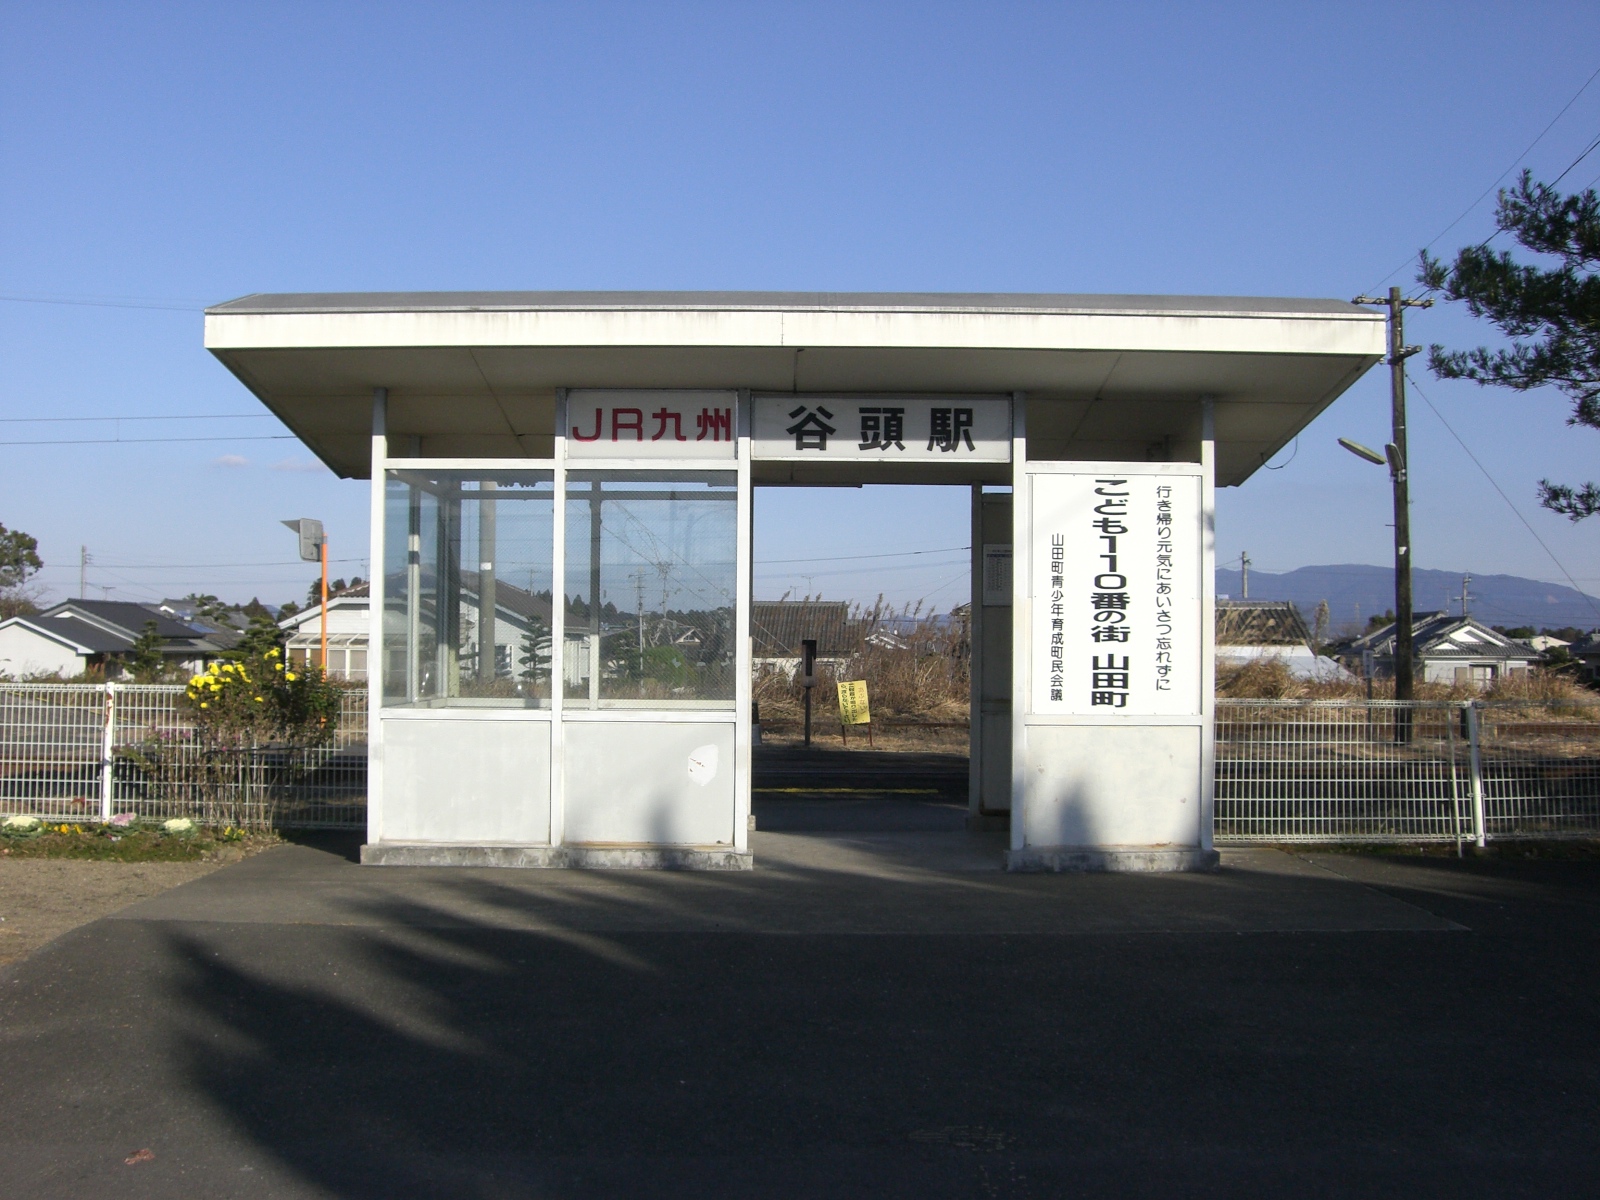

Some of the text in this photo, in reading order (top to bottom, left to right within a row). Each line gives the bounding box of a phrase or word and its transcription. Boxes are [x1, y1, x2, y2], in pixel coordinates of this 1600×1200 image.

[572, 406, 732, 443] JR九州
[785, 405, 976, 453] 谷頭駅
[1155, 485, 1173, 692] 行き帰り元気にあいさつ忘れずに
[1050, 532, 1065, 702] 山田町青少年育成町民会議
[1090, 653, 1130, 708] 山田町
